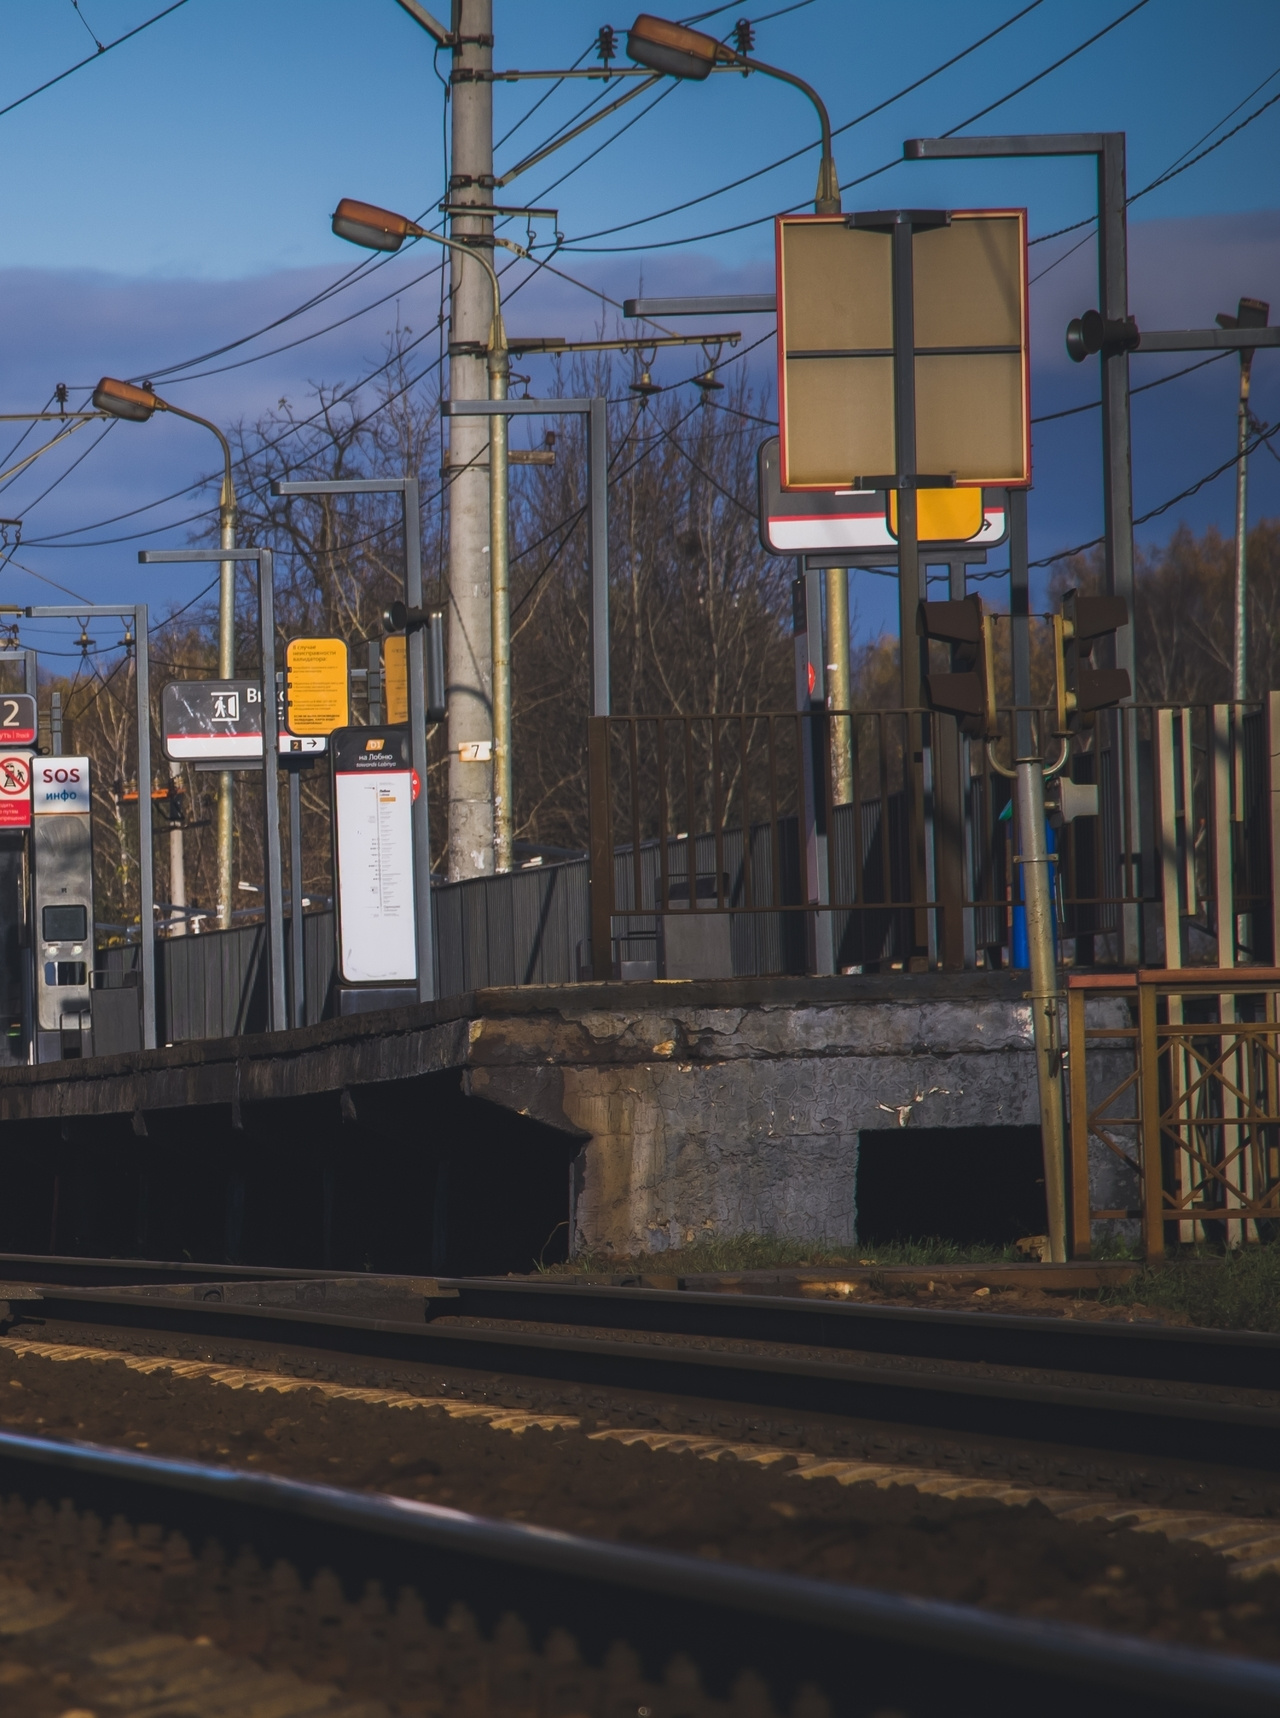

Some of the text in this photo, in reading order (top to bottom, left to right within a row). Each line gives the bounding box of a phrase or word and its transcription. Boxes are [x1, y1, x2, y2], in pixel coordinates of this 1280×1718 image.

[3, 700, 20, 727] 2
[293, 741, 299, 750] 2
[471, 744, 480, 758] 7
[368, 752, 393, 761] Лобню
[43, 768, 80, 784] SOS
[46, 789, 77, 802] инфо
